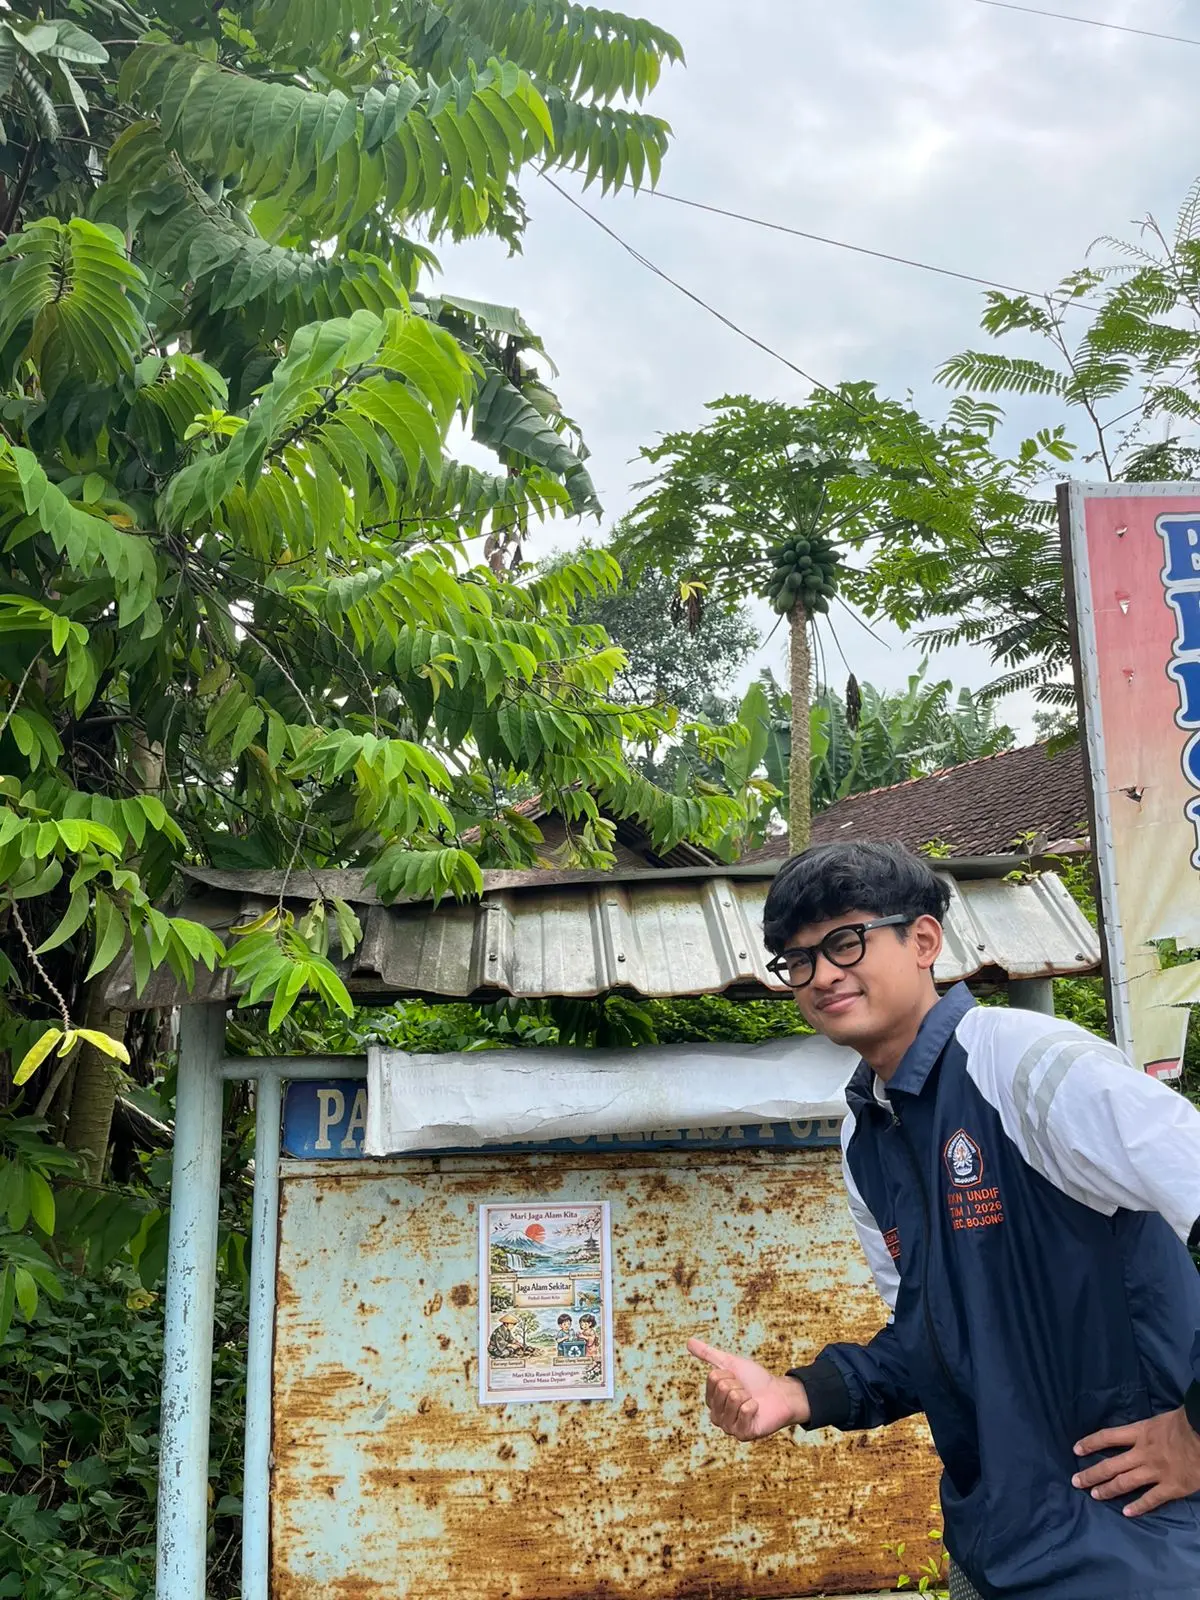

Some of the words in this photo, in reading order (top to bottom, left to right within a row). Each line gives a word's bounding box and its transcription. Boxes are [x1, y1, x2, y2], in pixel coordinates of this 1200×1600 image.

[974, 1200, 1002, 1214] 2026
[510, 1212, 527, 1220] Mari
[528, 1212, 543, 1221] Jaga
[544, 1211, 562, 1219] Alam
[966, 1213, 1004, 1228] BOJONG
[516, 1283, 531, 1293] Jaga
[531, 1283, 548, 1291] Alam
[548, 1282, 571, 1291] Sekitar
